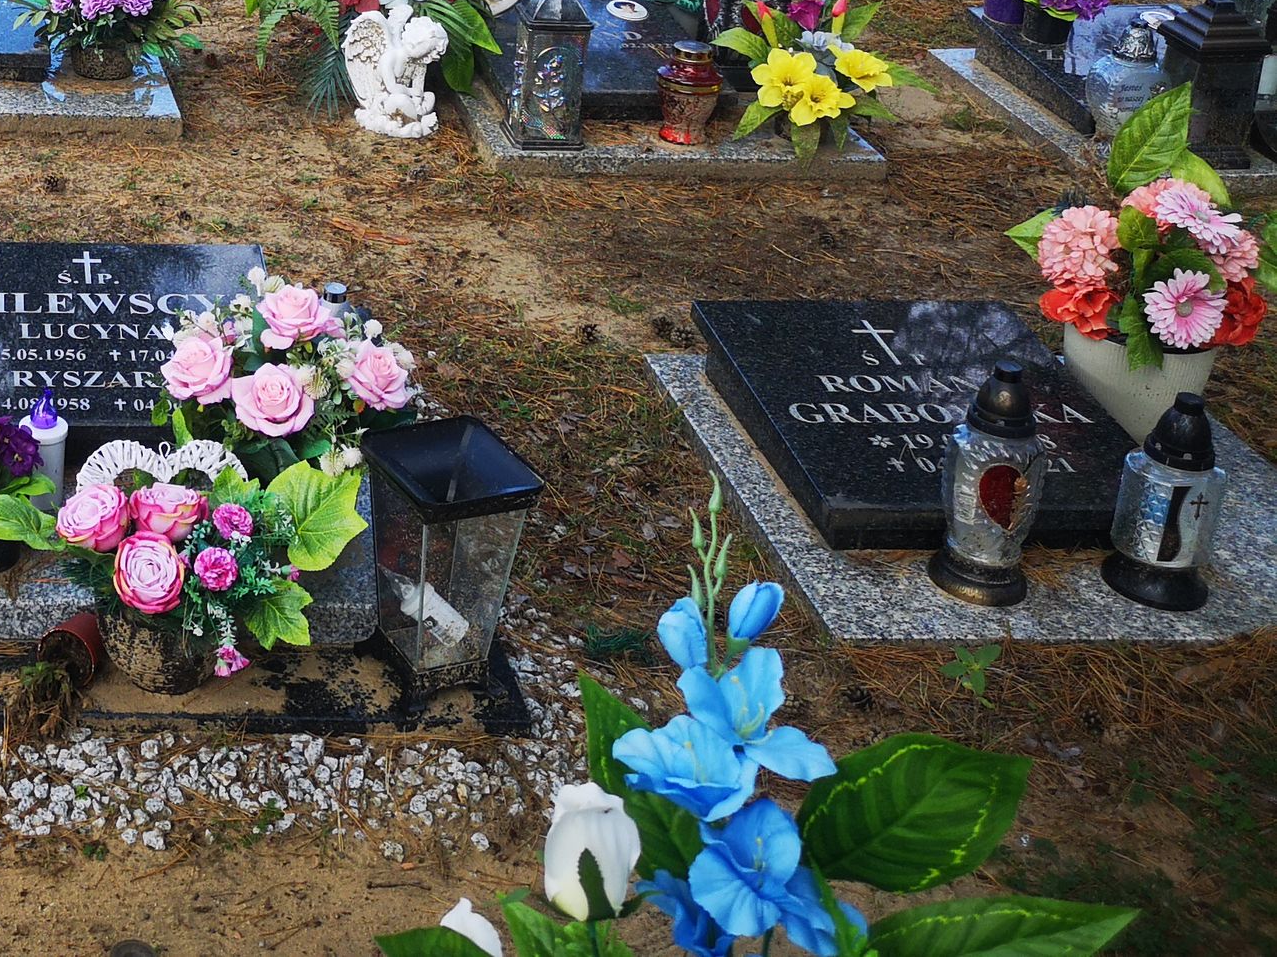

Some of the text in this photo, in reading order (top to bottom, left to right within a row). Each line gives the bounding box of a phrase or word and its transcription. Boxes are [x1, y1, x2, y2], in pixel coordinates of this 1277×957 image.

[19, 323, 165, 340] LUCYNA
[12, 370, 167, 388] RYSZAR
[814, 374, 981, 394] ROMAN
[788, 402, 1095, 424] GRABOKA
